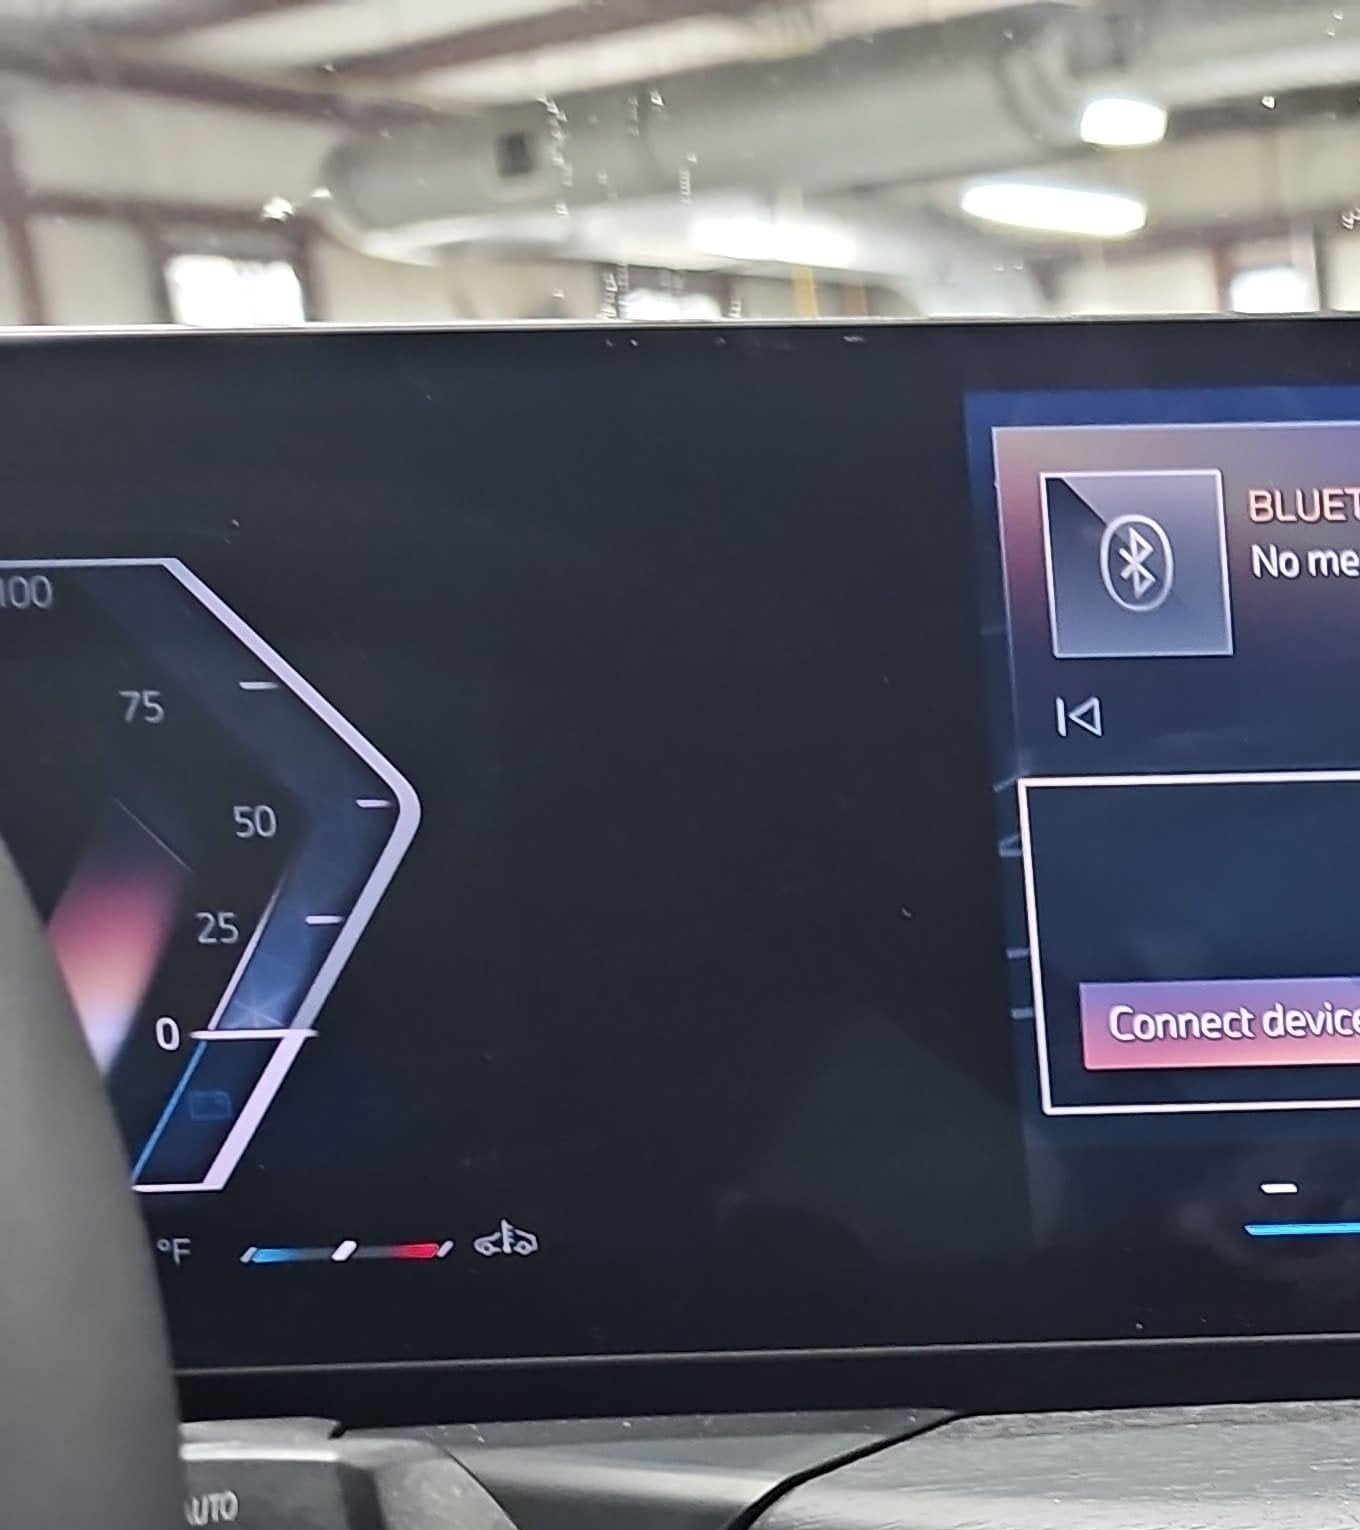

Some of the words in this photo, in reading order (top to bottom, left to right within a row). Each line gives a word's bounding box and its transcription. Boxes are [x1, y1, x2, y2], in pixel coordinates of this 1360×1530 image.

[1251, 543, 1301, 579] No
[118, 689, 166, 724] 75
[232, 804, 278, 839] 50
[195, 911, 240, 944] 25
[155, 1016, 181, 1051] 0
[1108, 1004, 1256, 1042] Connect
